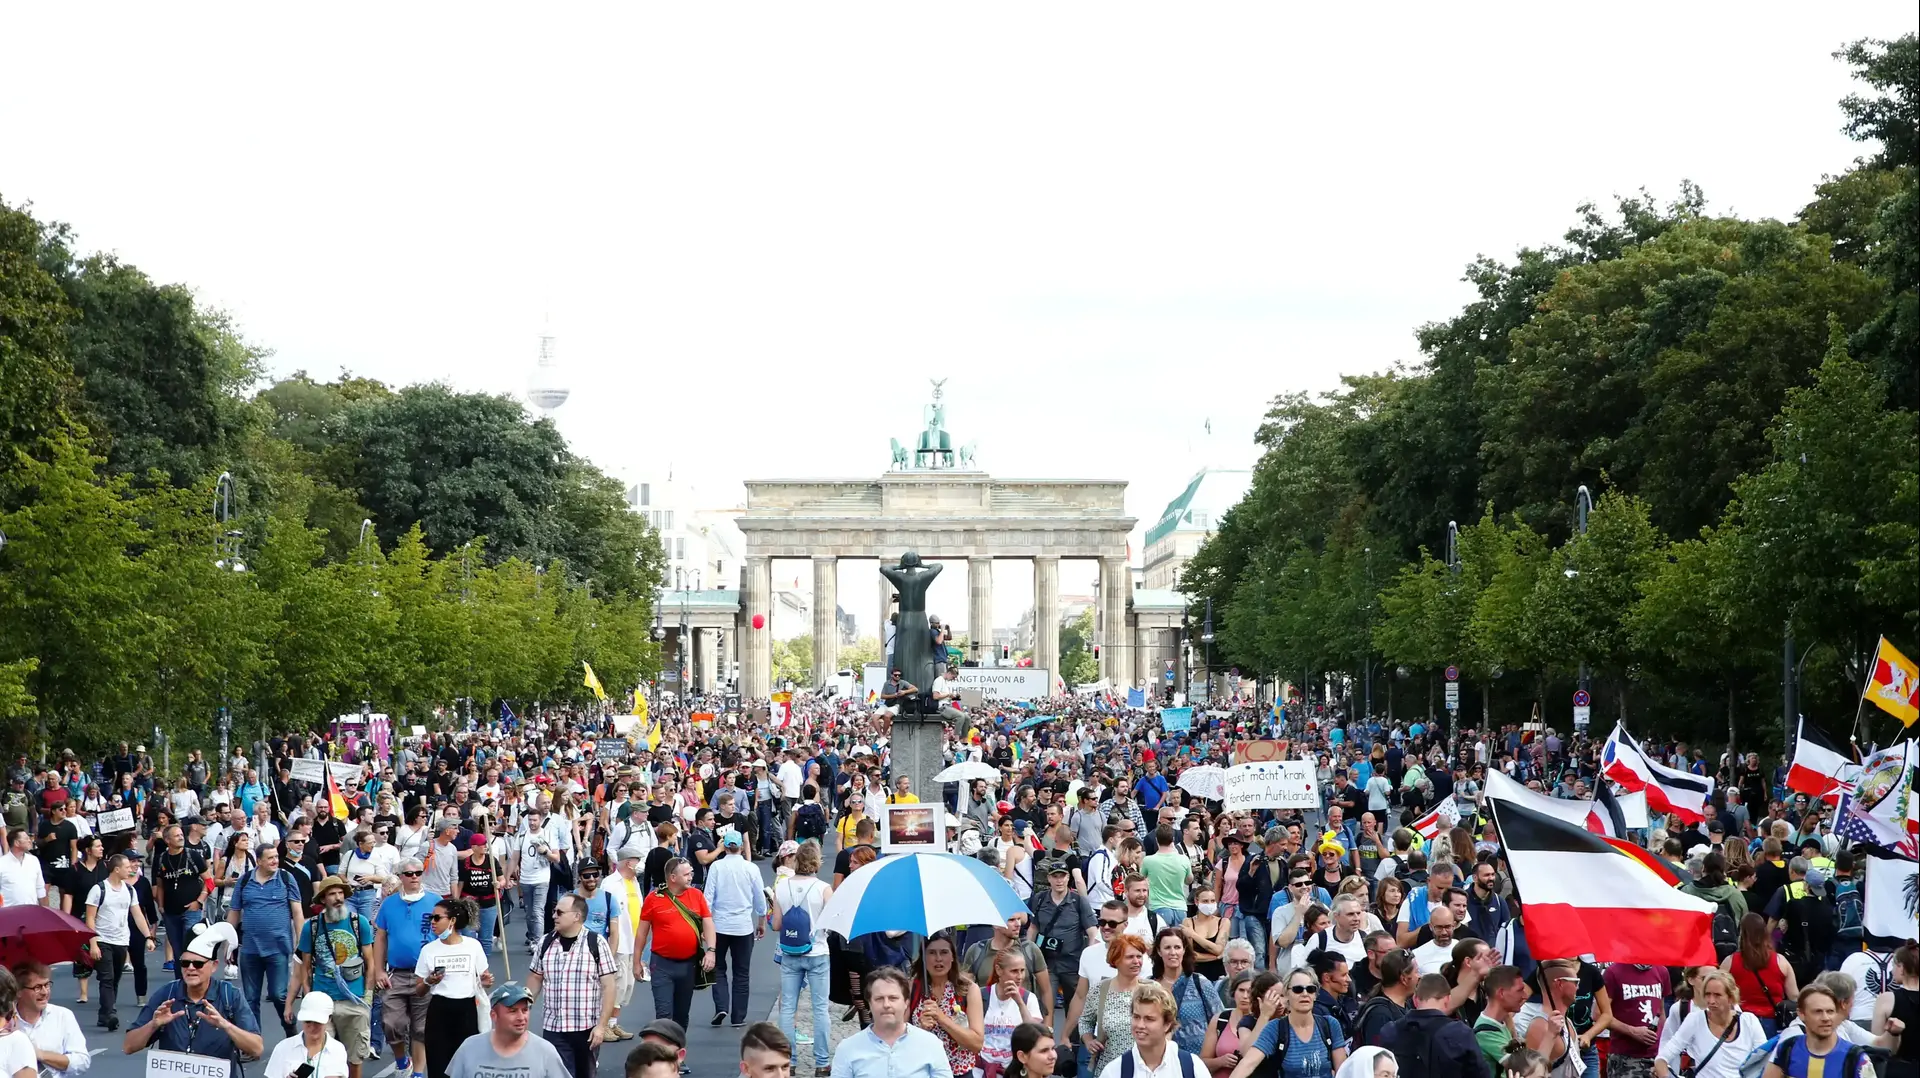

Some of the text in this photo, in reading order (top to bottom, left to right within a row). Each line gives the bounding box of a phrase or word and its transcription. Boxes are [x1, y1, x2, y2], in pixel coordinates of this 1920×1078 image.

[980, 675, 1011, 683] DAVON
[1245, 740, 1277, 761] Q
[1250, 769, 1279, 781] macht
[1284, 769, 1307, 780] krank
[1047, 937, 1058, 948] Q
[1622, 983, 1662, 1000] BERLIN
[151, 1058, 224, 1078] BETREUTES
